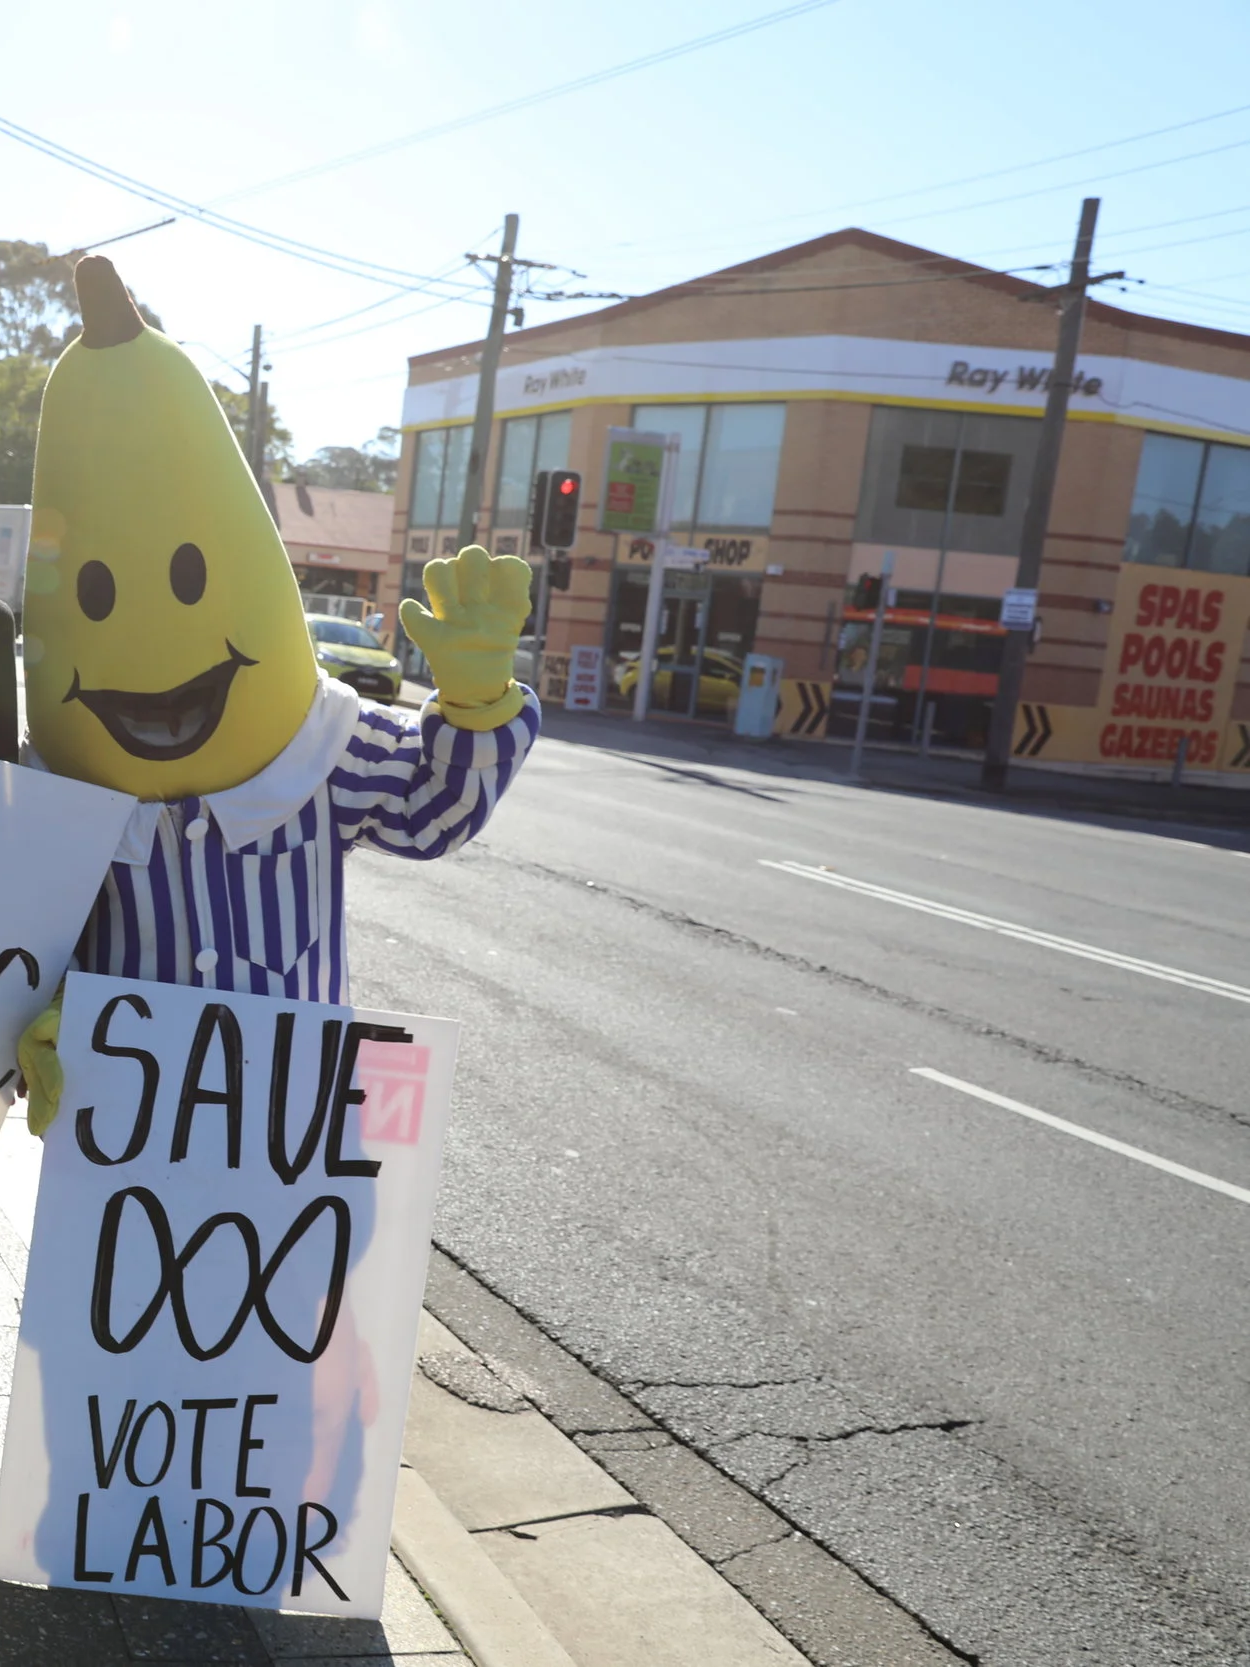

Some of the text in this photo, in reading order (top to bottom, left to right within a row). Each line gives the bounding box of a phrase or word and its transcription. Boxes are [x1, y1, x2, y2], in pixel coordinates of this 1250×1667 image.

[947, 360, 1009, 394] Ray
[704, 537, 751, 566] SHOP
[1136, 584, 1224, 633] SPAS
[1119, 633, 1225, 683] POOLS
[1111, 682, 1215, 724] SAUNAS
[75, 994, 413, 1186] SAVE
[88, 1394, 278, 1498] VOTE
[74, 1493, 350, 1601] LABOR
